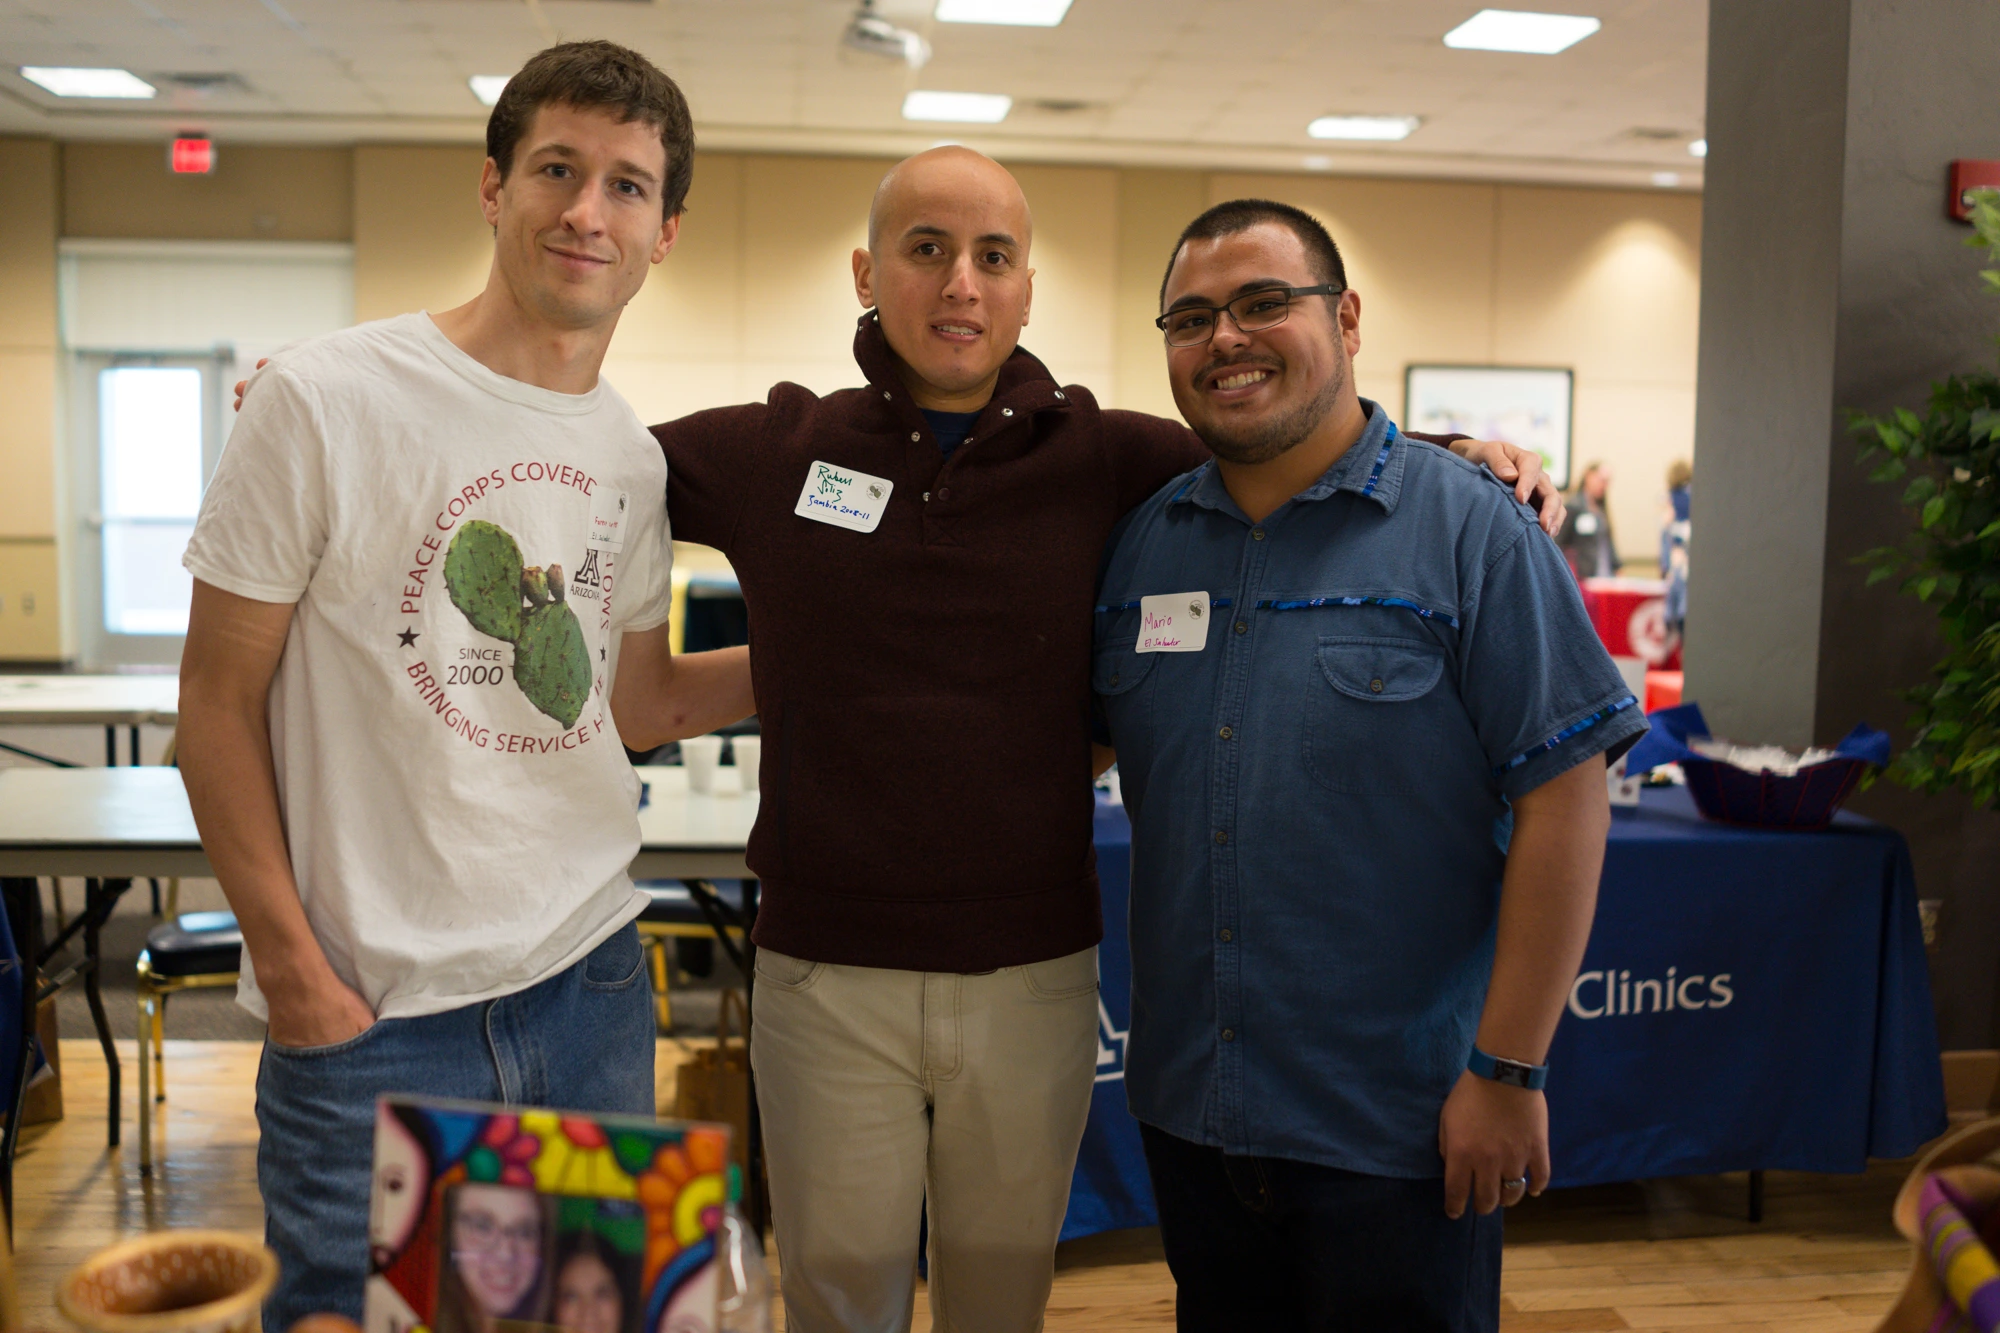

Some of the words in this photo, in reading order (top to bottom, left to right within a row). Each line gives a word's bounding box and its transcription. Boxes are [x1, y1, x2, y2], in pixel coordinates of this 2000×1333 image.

[401, 534, 441, 614] PEACE
[436, 469, 505, 531] CORPS
[511, 462, 598, 495] COVERD
[570, 584, 600, 602] ARIZONA
[1144, 612, 1172, 632] Mario
[458, 648, 503, 662] SINCE
[446, 665, 505, 686] 2000
[407, 661, 490, 748] BRINGING
[494, 726, 591, 754] SERVICE
[1567, 966, 1735, 1020] Clinics
